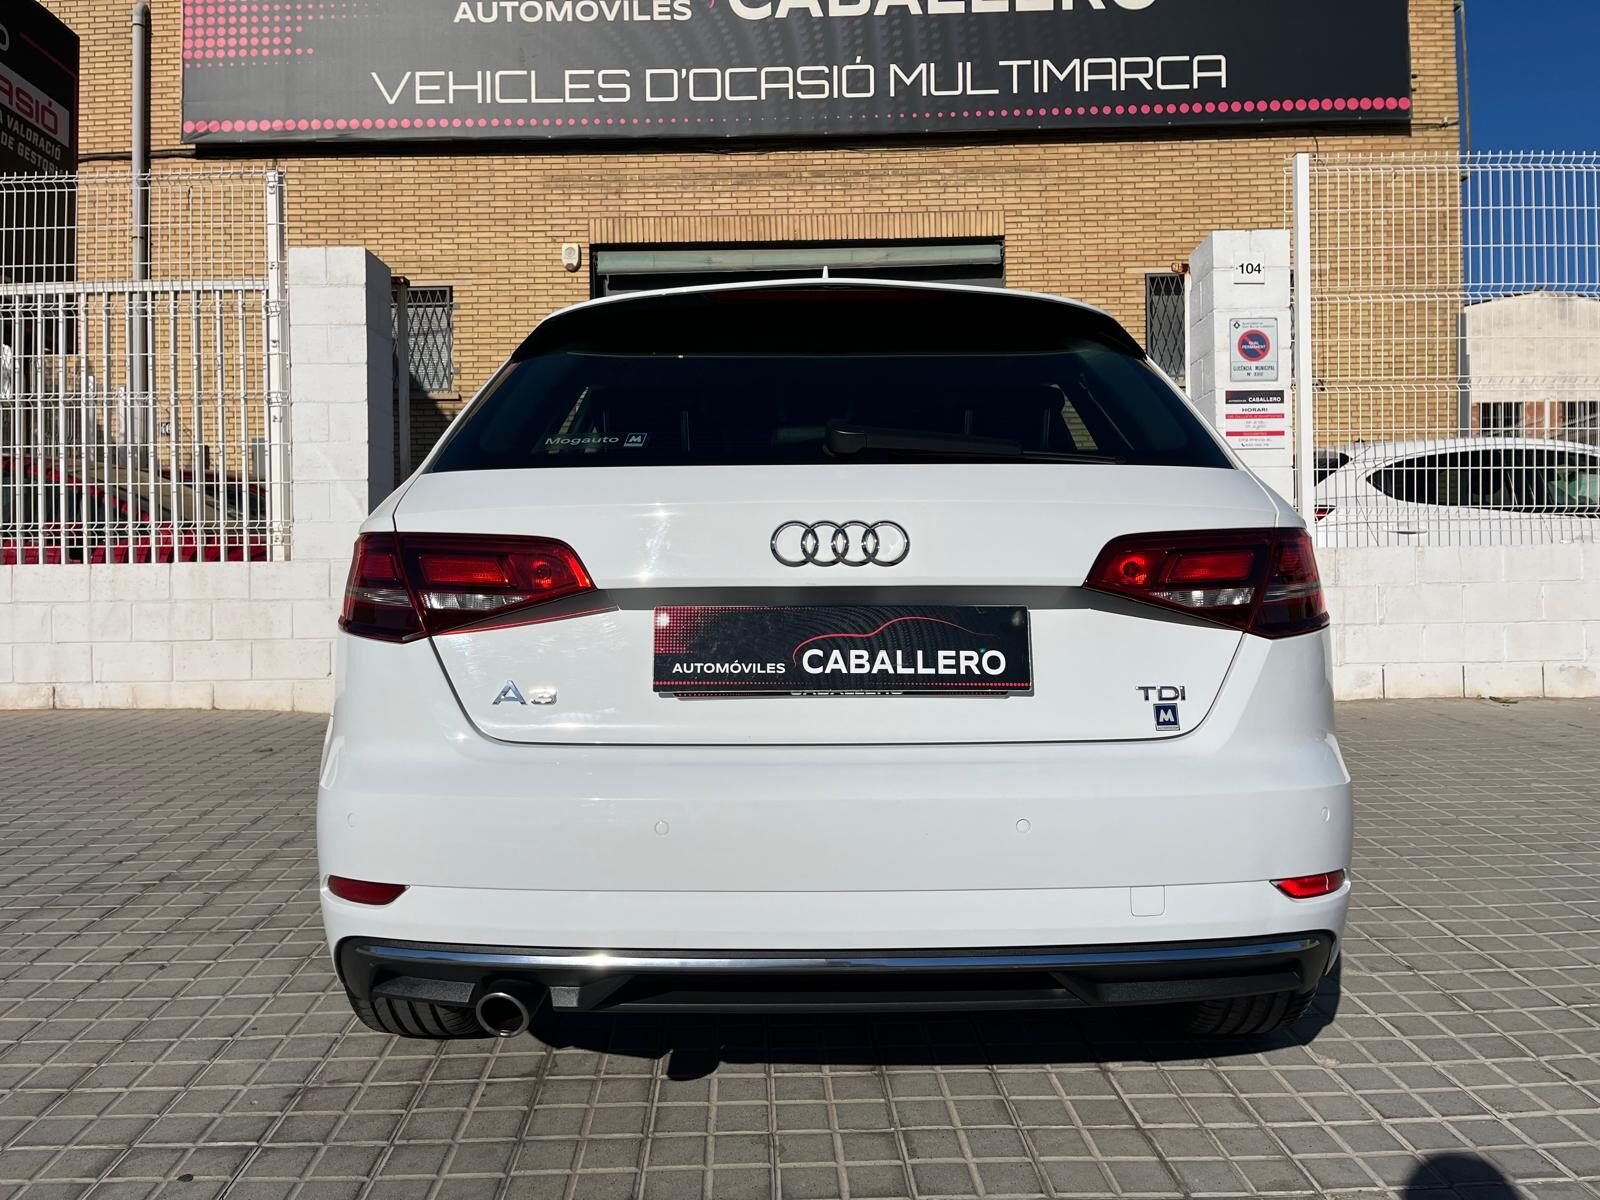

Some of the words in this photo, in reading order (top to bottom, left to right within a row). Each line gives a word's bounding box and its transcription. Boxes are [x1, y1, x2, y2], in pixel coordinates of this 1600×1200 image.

[370, 69, 631, 106] VEHICLES
[645, 56, 875, 103] D'OCASIÓ
[889, 54, 1227, 98] MULTIMARCA
[0, 130, 15, 151] DE
[6, 113, 61, 161] VALORACIÓ
[1239, 263, 1262, 274] 104
[545, 435, 619, 446] Mogauto
[672, 660, 786, 675] AUTOMÓVILES
[802, 649, 1006, 676] CABALLERO
[1159, 708, 1175, 723] M
